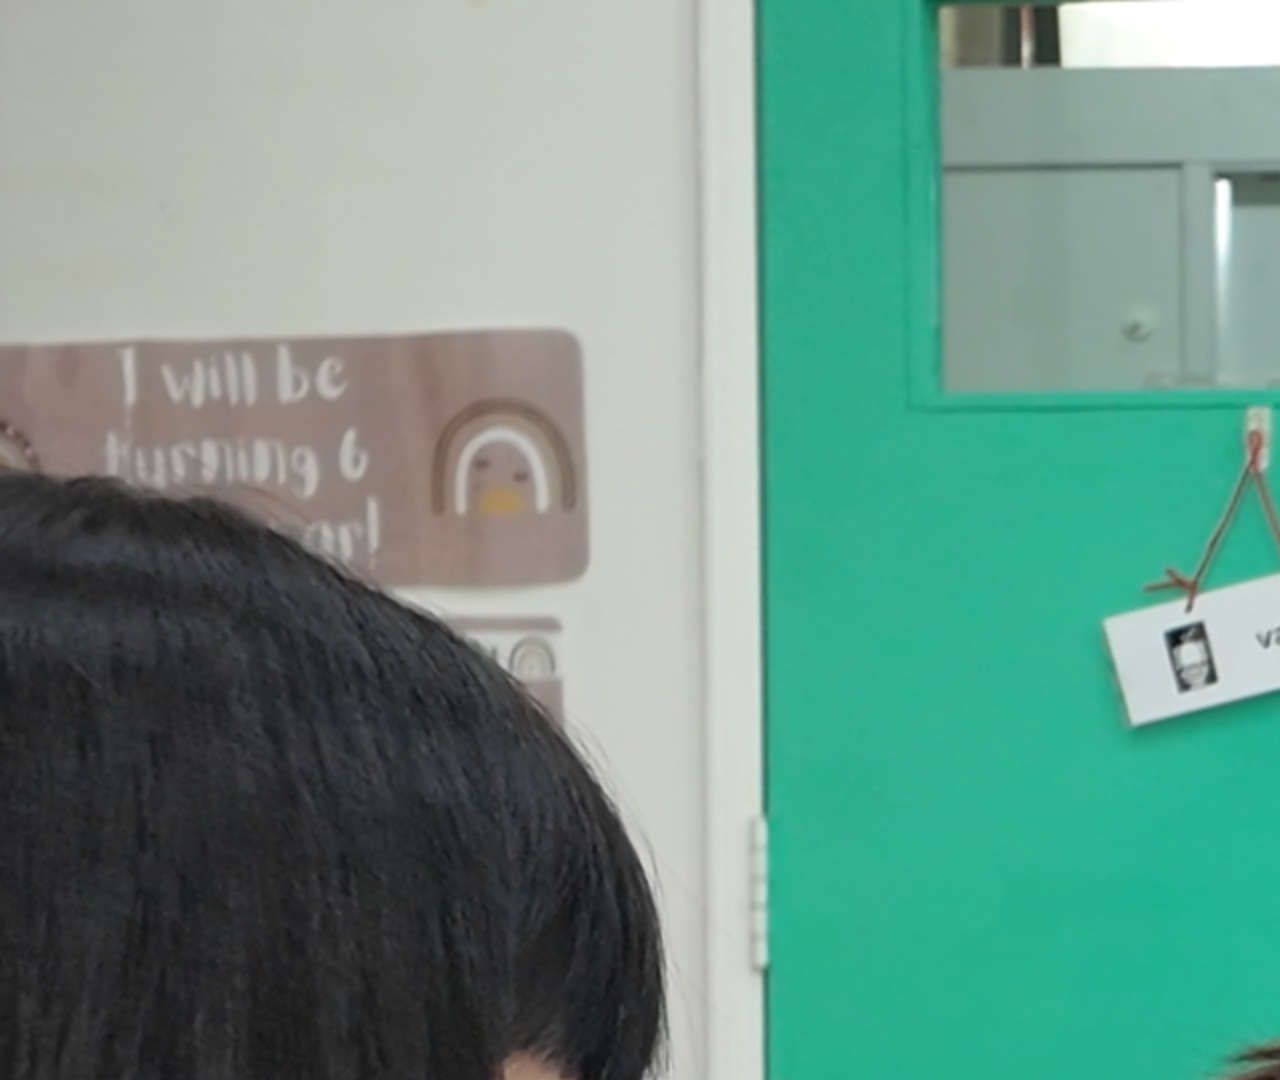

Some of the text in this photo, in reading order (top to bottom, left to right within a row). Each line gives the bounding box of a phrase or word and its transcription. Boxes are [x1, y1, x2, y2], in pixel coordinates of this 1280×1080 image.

[116, 344, 348, 409] I will be
[338, 425, 371, 483] 6
